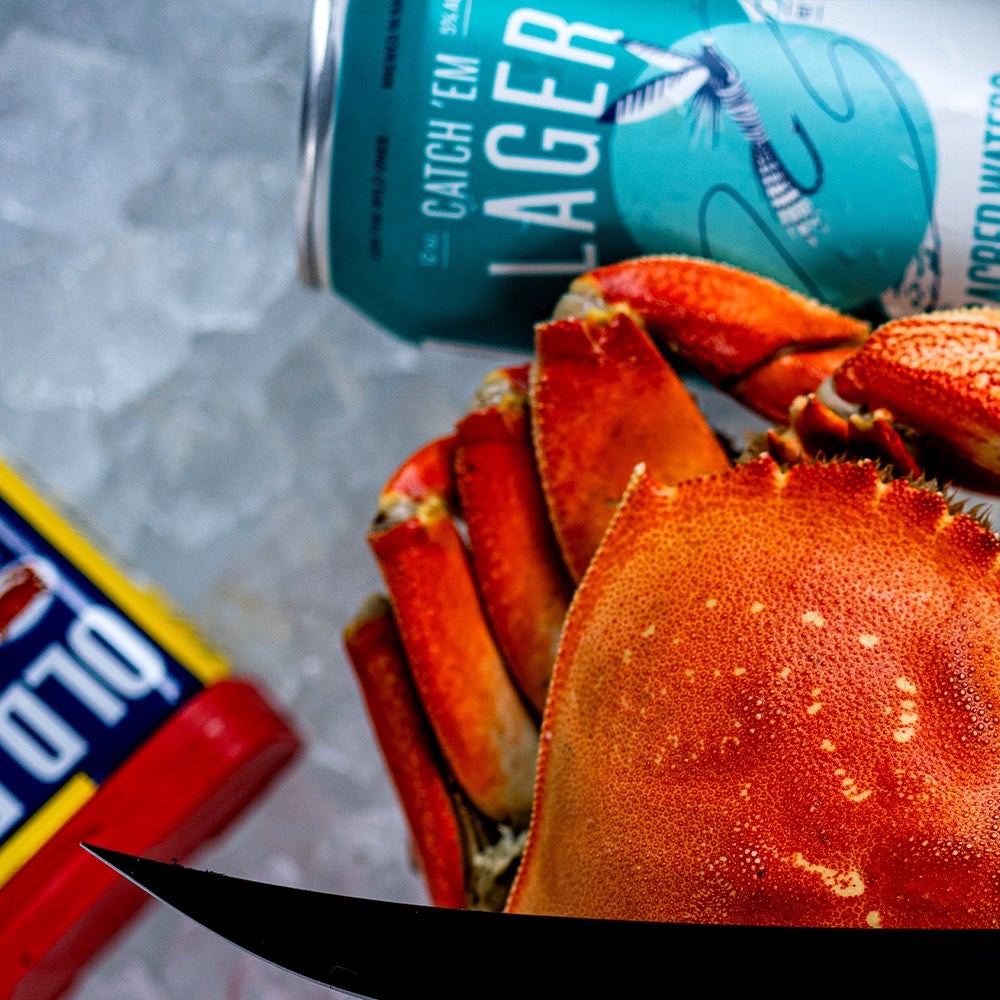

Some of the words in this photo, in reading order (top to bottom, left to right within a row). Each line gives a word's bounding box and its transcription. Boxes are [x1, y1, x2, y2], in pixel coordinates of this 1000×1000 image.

[421, 120, 473, 219] CATCH
[482, 7, 624, 275] LAGER
[0, 603, 168, 784] OLD
